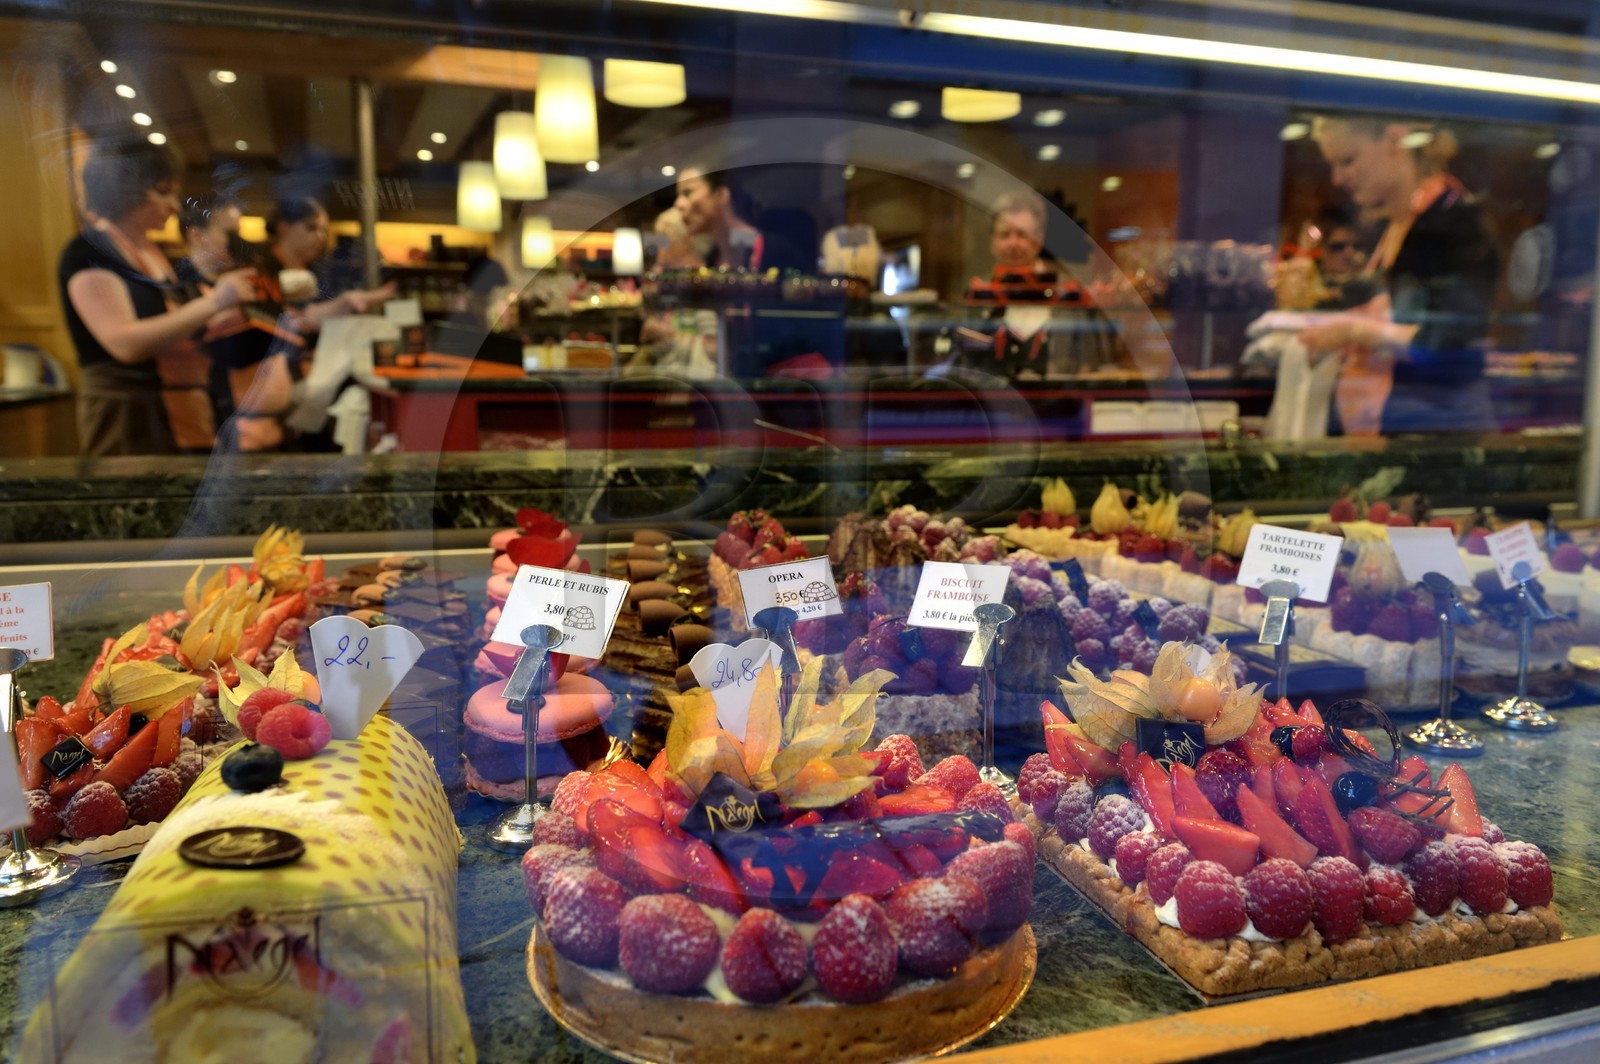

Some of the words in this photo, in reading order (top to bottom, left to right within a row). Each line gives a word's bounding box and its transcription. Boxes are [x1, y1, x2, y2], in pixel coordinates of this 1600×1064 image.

[1262, 532, 1326, 551] TARTELETTE
[1259, 544, 1322, 561] FRAMBOISES
[1271, 564, 1291, 574] 3,80
[1293, 568, 1300, 576] €
[768, 571, 804, 584] OPERA
[940, 577, 985, 589] BISCUIT
[529, 575, 561, 588] PERLE
[563, 579, 577, 590] ET
[578, 583, 609, 595] RUBIS
[927, 589, 990, 602] FRAMBOISE
[15, 606, 25, 614] la
[543, 603, 565, 615] 3,80
[802, 605, 816, 613] 4,20
[817, 603, 823, 611] €
[942, 611, 949, 620] €
[949, 612, 957, 621] la
[0, 633, 28, 642] fruits
[33, 647, 39, 655] €
